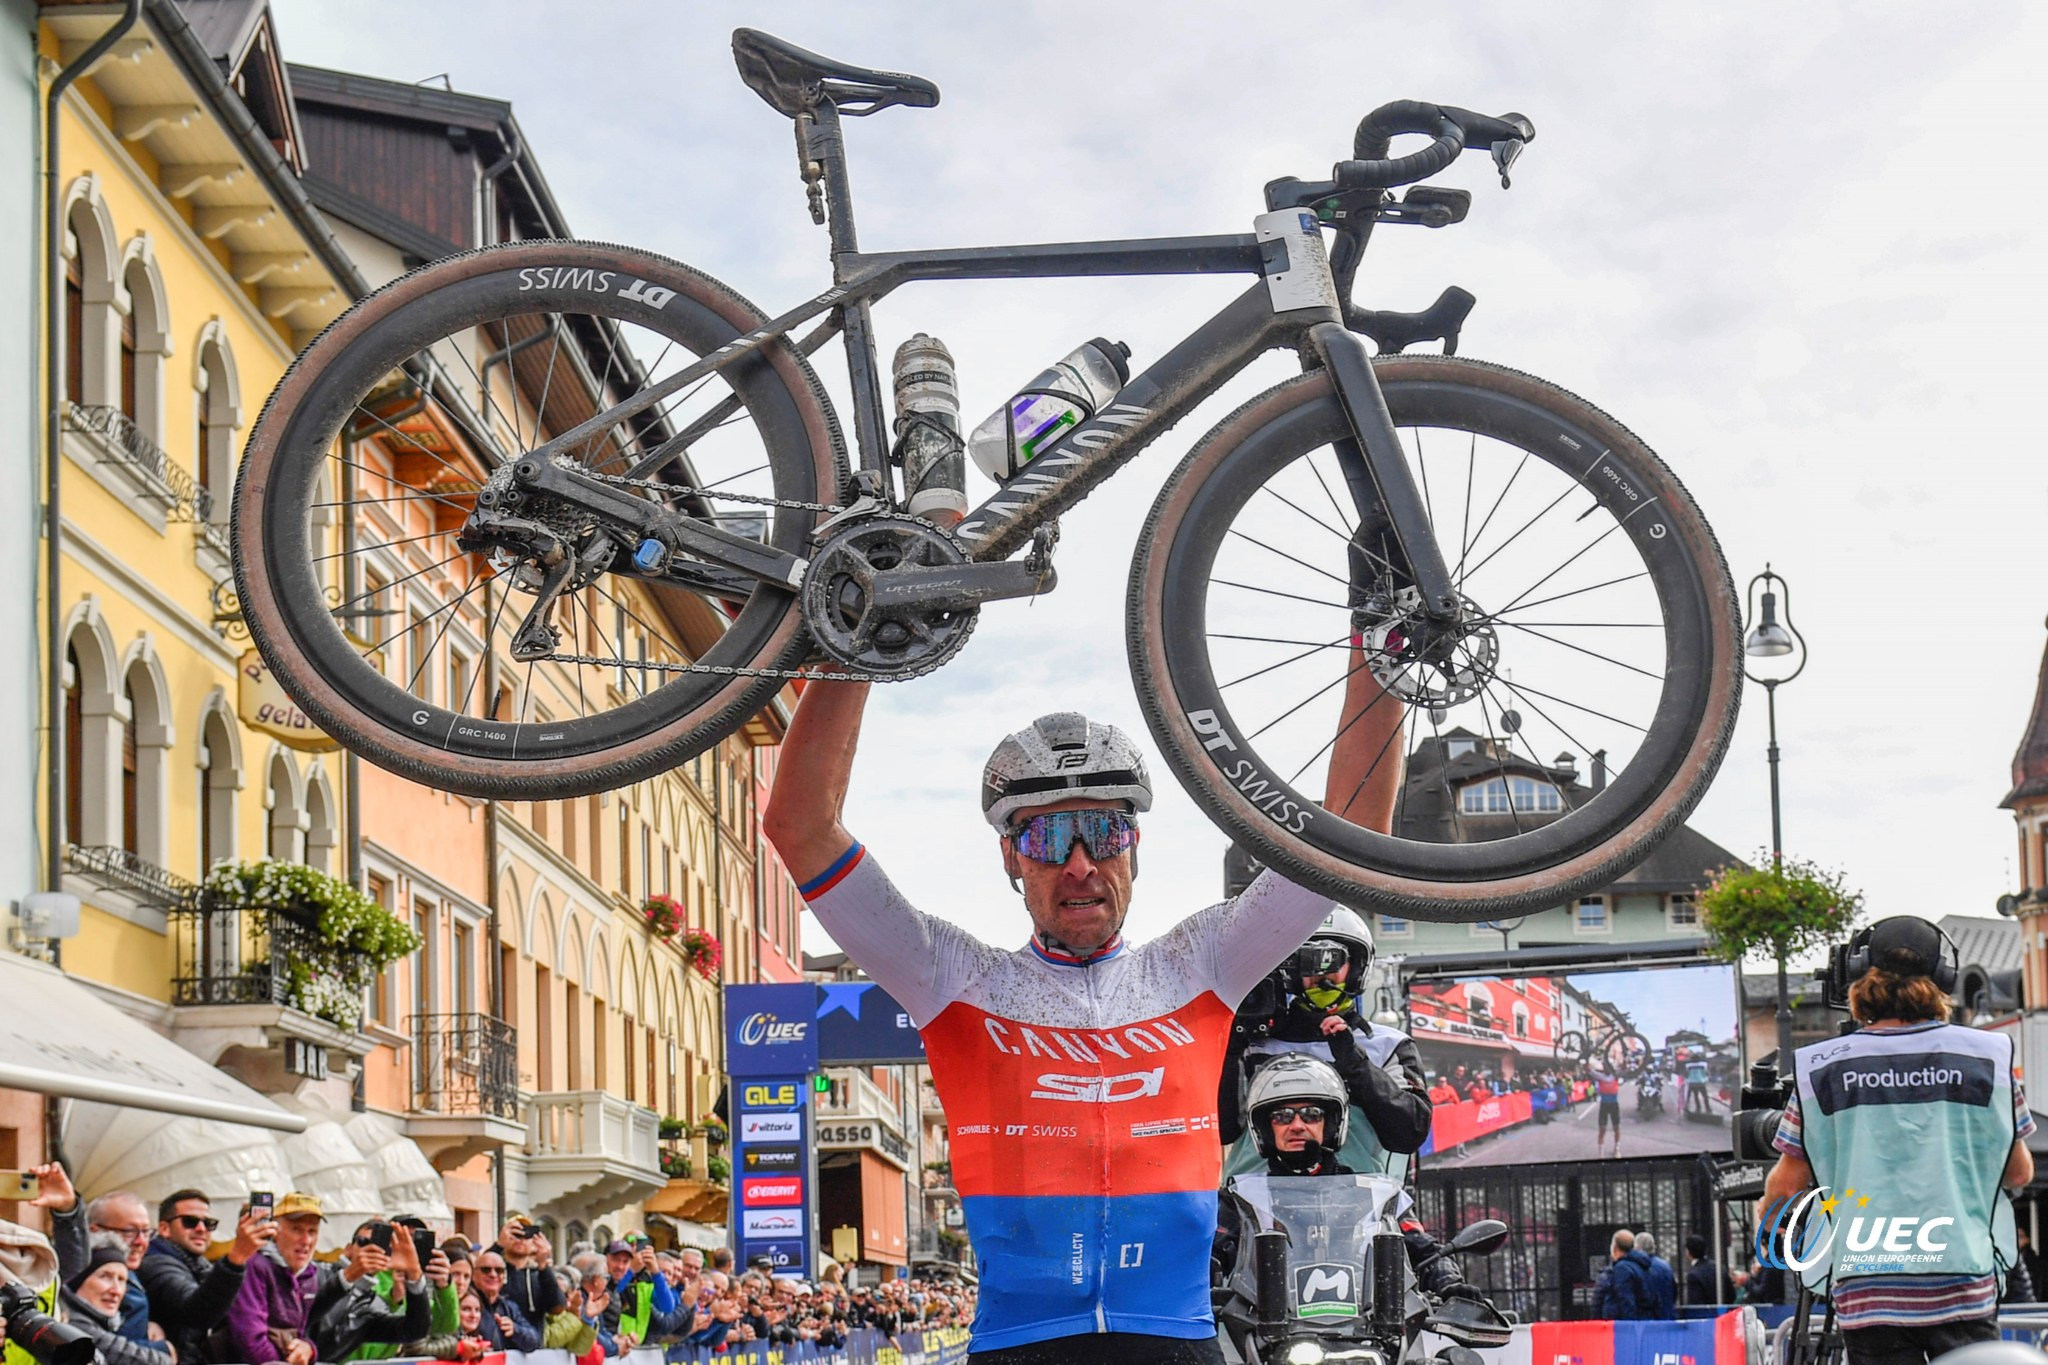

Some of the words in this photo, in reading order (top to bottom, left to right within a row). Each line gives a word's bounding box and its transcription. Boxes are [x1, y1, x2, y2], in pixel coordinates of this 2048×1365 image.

[518, 267, 616, 293] SWISS
[617, 279, 677, 310] DT
[1602, 466, 1621, 485] 1400
[1619, 483, 1638, 501] GRC
[458, 727, 481, 738] GRC
[484, 731, 507, 741] 1400
[1187, 709, 1238, 752] DT
[1223, 760, 1314, 833] SWISS
[767, 1022, 808, 1038] UEC
[984, 1017, 1196, 1064] CANYON
[294, 1041, 328, 1080] BAR
[1842, 1066, 1962, 1092] Production
[957, 1124, 990, 1136] SCHWALBE
[1005, 1124, 1028, 1136] DT
[1032, 1125, 1077, 1137] SWISS
[758, 1152, 797, 1161] TOPEAK
[761, 1185, 798, 1197] ENERVIT
